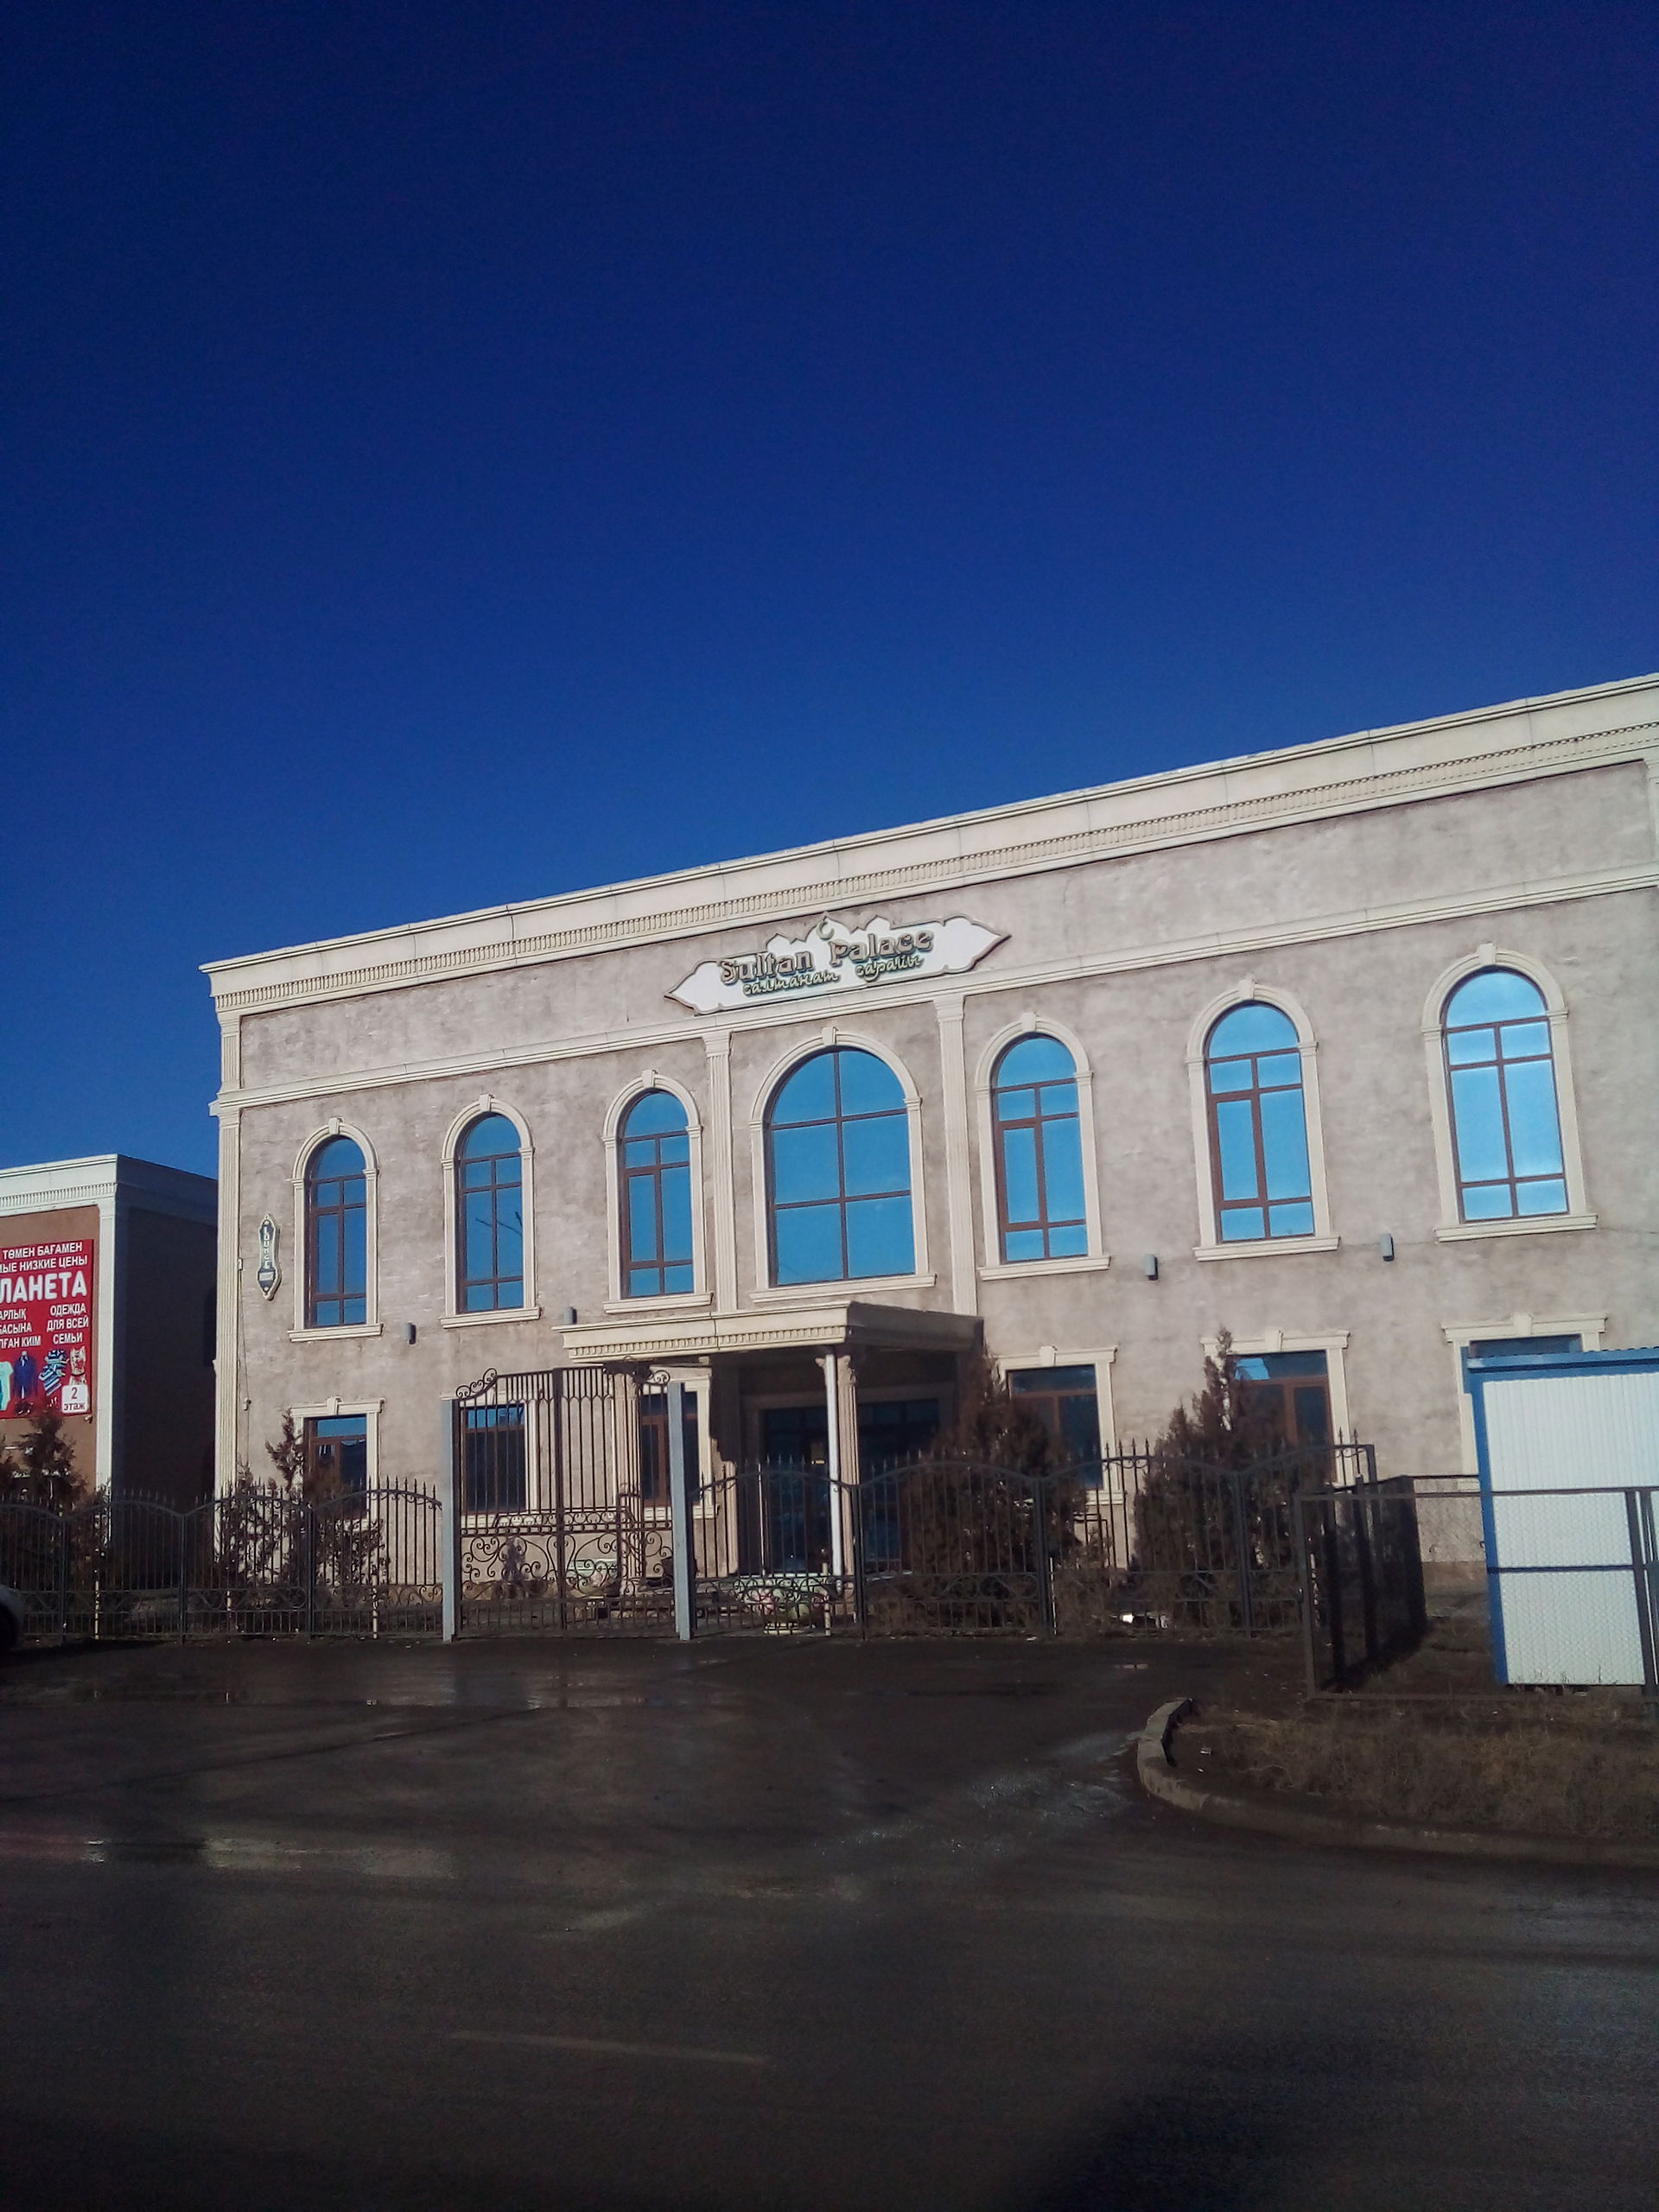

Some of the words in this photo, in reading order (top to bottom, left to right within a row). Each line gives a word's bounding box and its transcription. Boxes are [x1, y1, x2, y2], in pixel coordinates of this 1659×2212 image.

[721, 950, 813, 984] Sultan
[830, 932, 933, 966] Palace
[3, 1247, 35, 1260] ТӨМЕН
[37, 1242, 83, 1256] БАҒАМЕН
[0, 1262, 17, 1273] ЫЕ
[19, 1258, 57, 1272] НИЗКИЕ
[59, 1255, 88, 1268] ЦЕНЫ
[50, 1303, 86, 1317] ОДЕЖДА
[47, 1319, 65, 1332] ДЛЯ
[66, 1315, 89, 1329] ВСЕЙ
[22, 1336, 41, 1347] КИІМ
[53, 1332, 83, 1344] СЕМЬИ
[71, 1387, 78, 1400] 2
